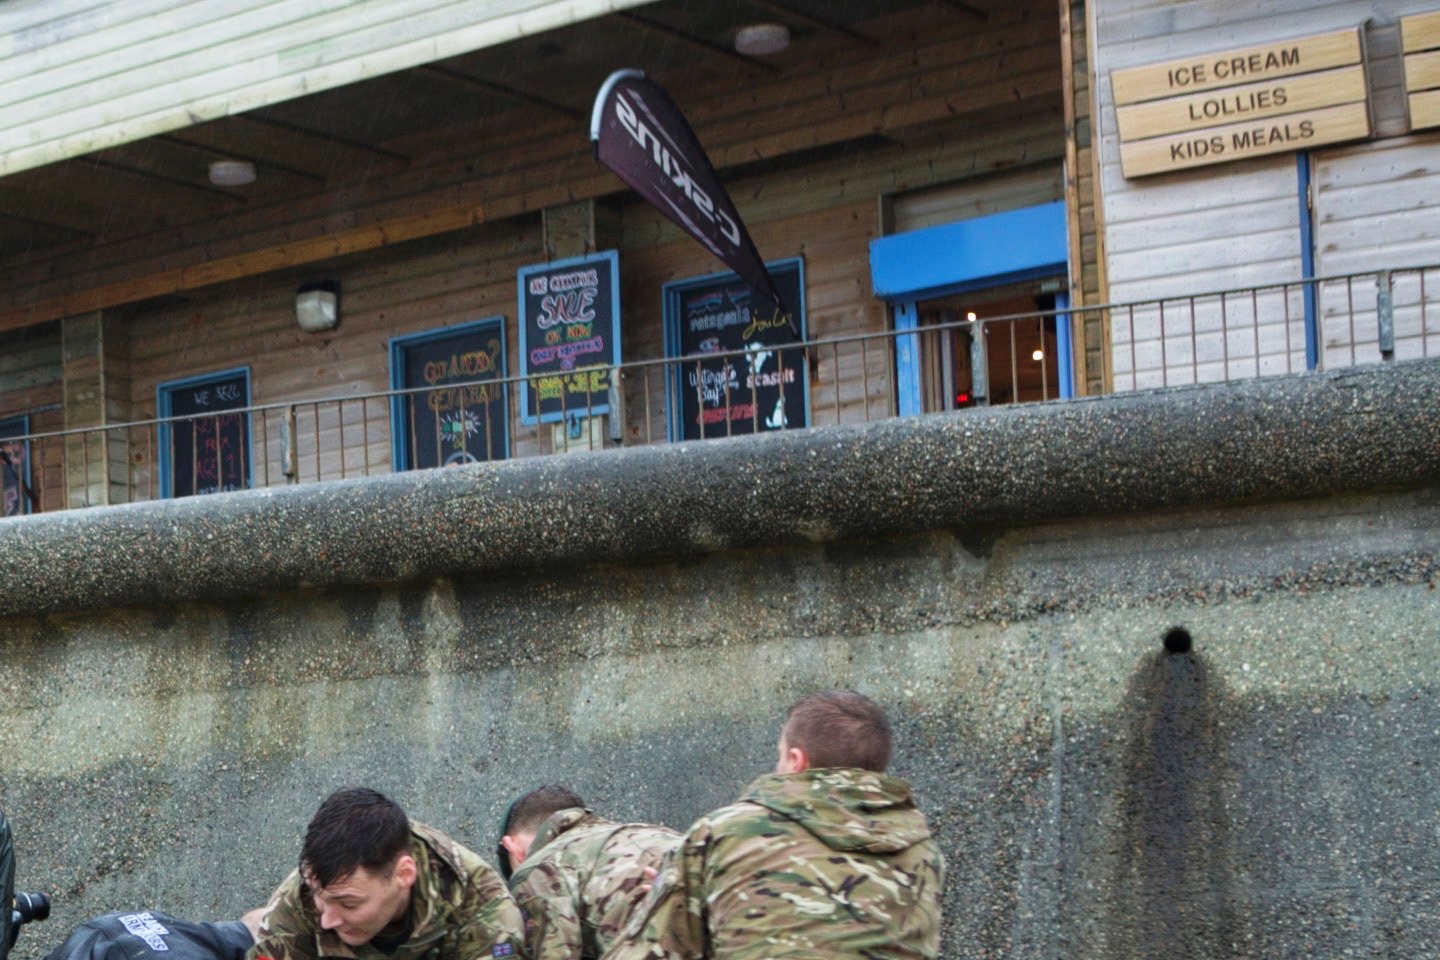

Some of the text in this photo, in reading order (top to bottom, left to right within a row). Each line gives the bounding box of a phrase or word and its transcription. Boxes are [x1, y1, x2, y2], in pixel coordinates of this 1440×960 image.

[1167, 47, 1300, 88] ICE CREAM
[1189, 87, 1288, 121] LOLLIES
[1170, 120, 1315, 161] KIDS MEALS
[537, 287, 598, 329] SALE
